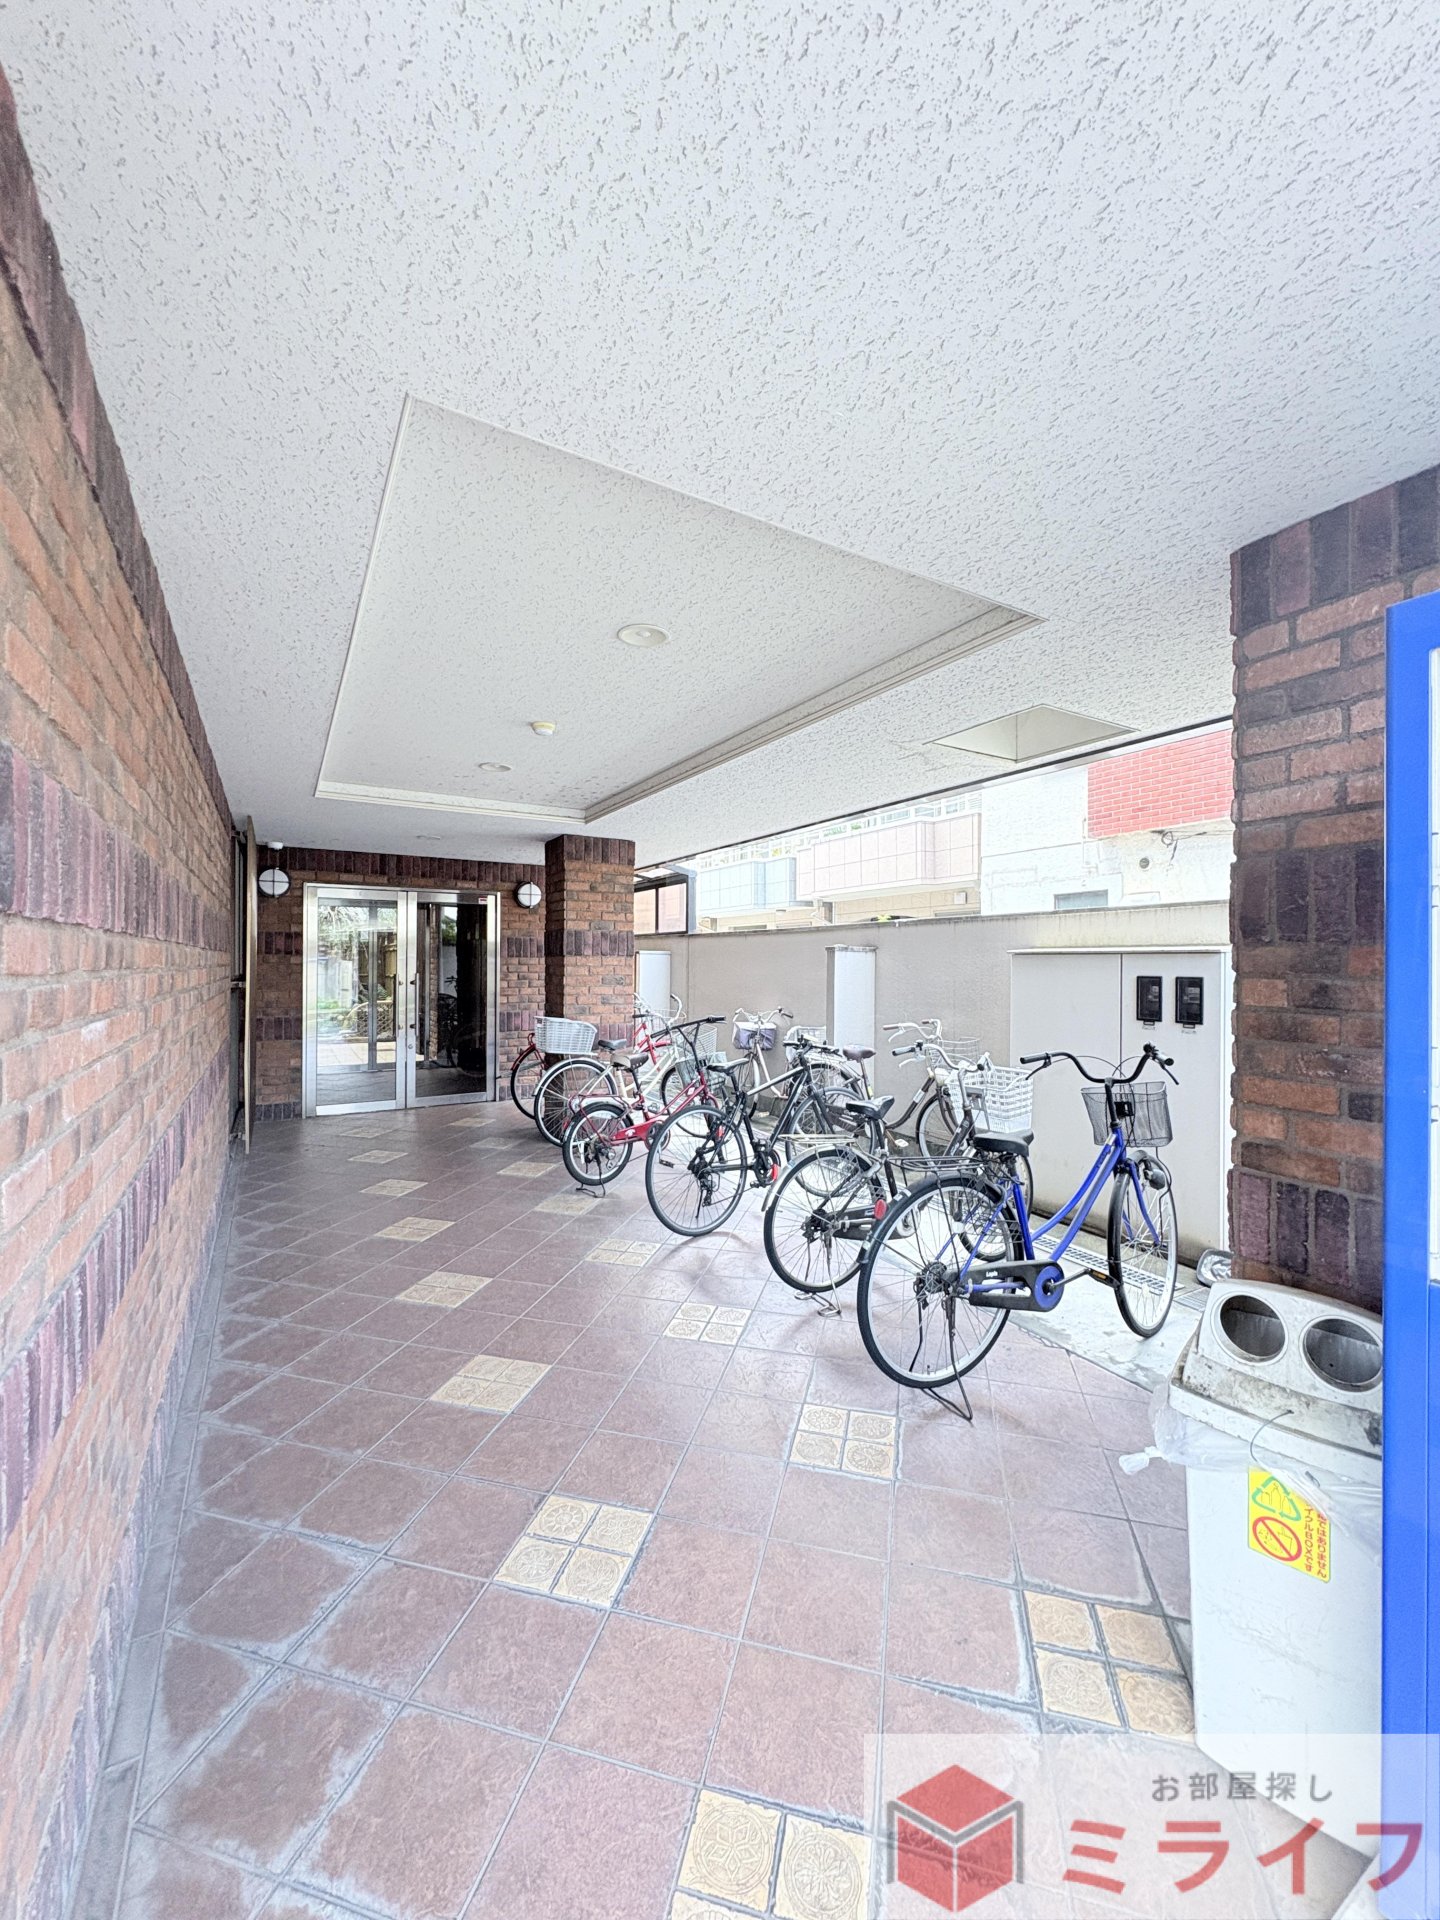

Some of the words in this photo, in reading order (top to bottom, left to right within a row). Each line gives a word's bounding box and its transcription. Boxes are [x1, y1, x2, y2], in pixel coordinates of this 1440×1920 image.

[1304, 1503, 1314, 1572] イクルBOXです
